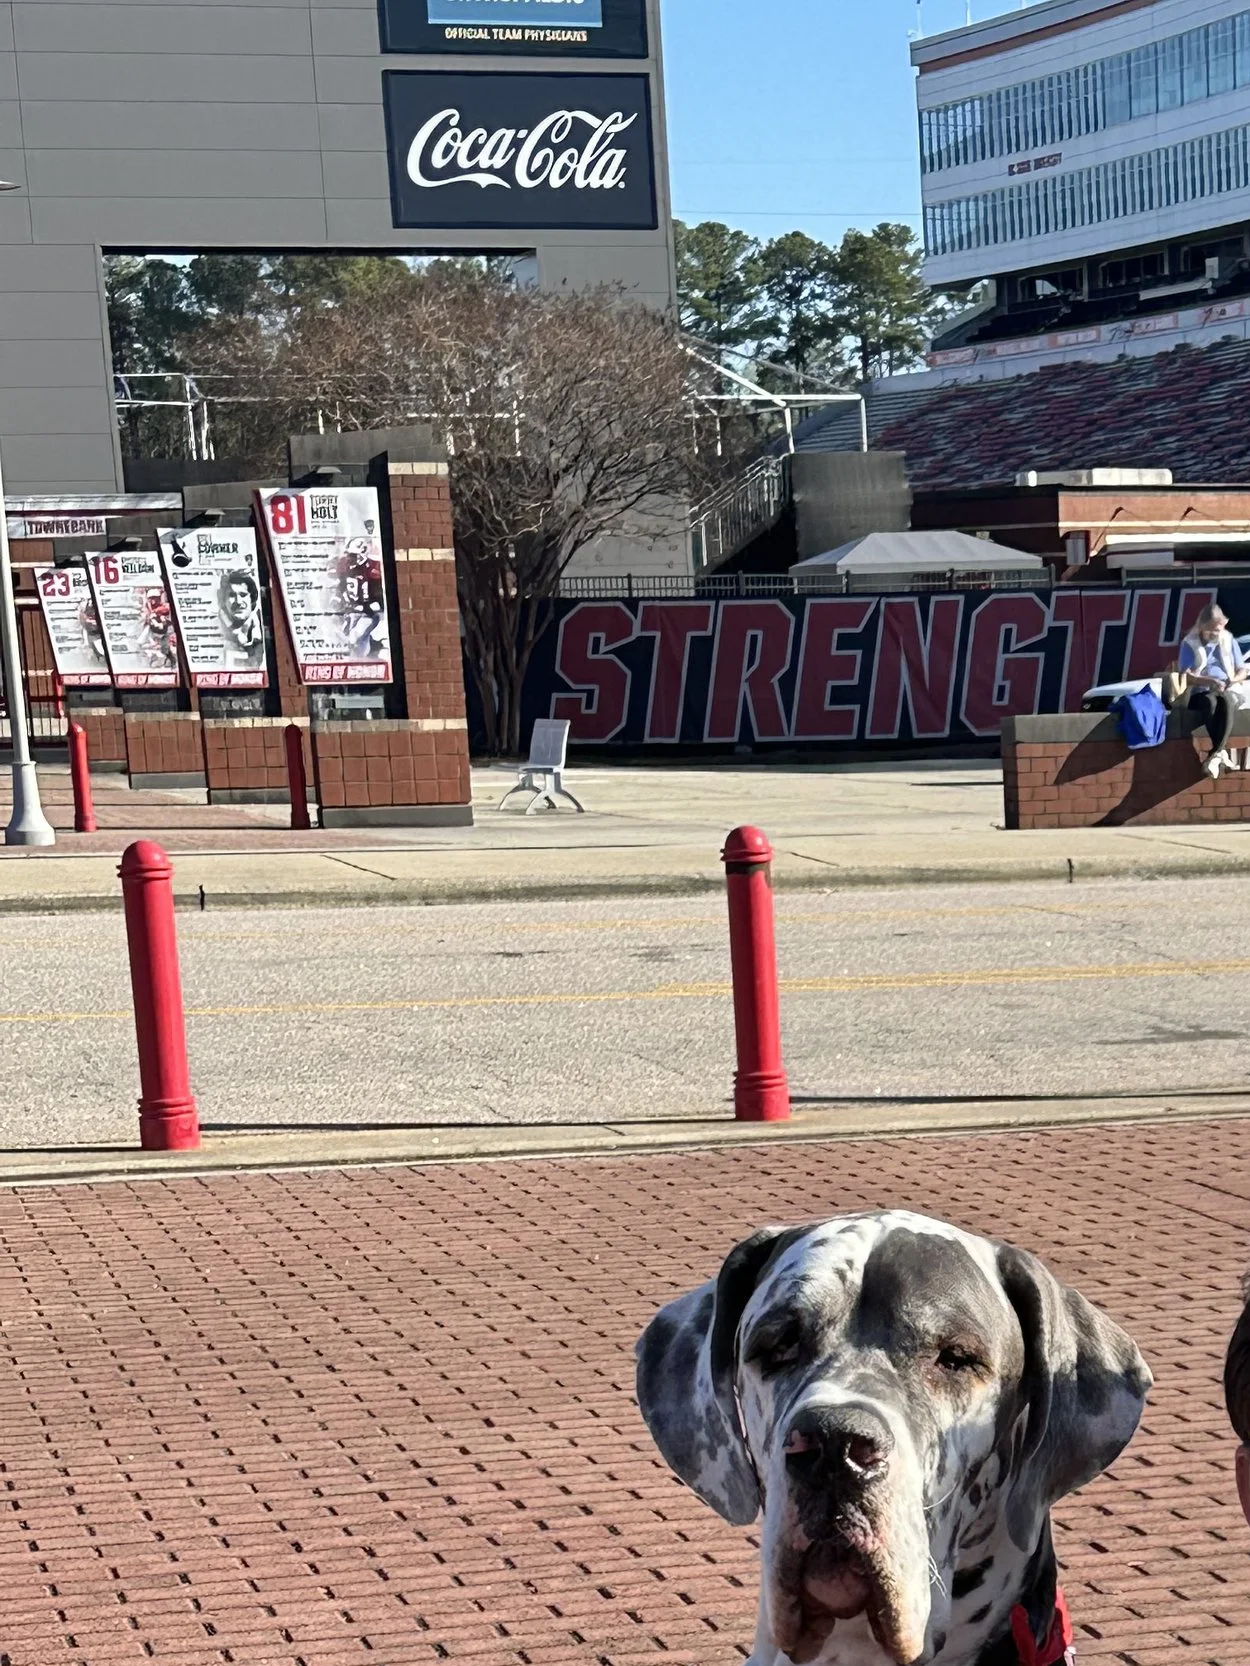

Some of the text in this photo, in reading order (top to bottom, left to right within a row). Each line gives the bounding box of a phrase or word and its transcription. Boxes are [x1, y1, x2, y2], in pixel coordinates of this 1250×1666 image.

[493, 28, 522, 41] TEAM
[270, 494, 307, 534] 81
[93, 556, 119, 584] 16
[43, 571, 70, 597] 23
